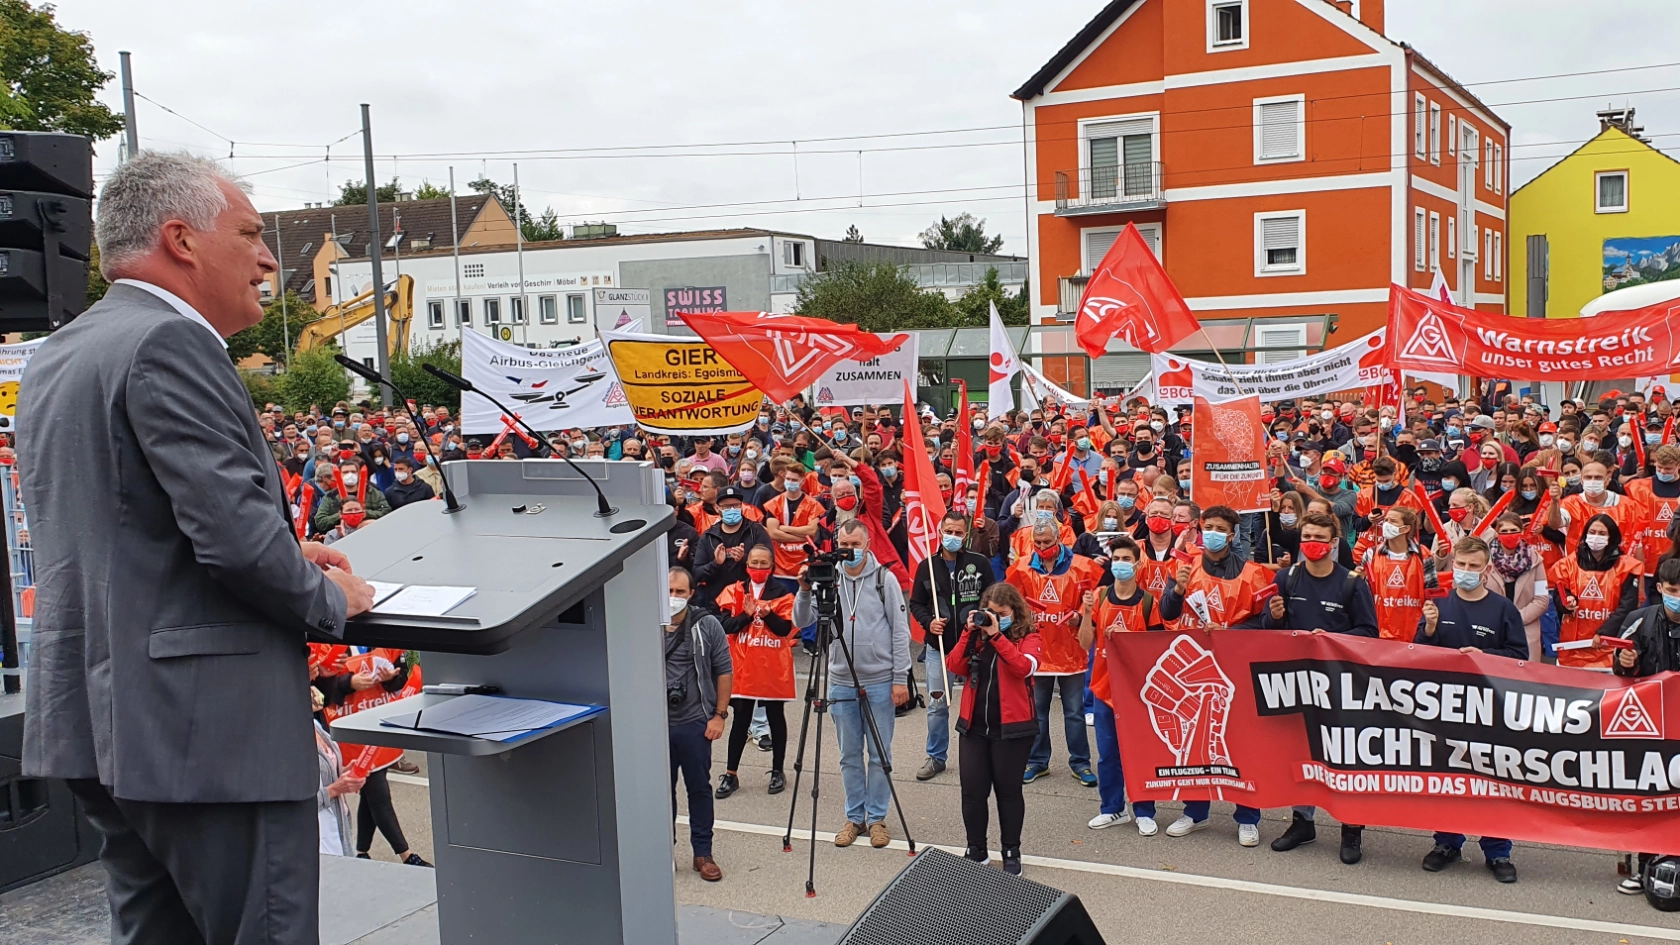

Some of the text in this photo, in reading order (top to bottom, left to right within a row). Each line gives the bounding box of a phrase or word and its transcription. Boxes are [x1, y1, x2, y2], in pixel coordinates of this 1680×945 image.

[487, 281, 509, 289] Verleih
[524, 280, 552, 288] Geschirr
[556, 278, 577, 286] Möbel
[667, 289, 723, 306] SWISS
[1476, 325, 1654, 355] Warnstreik
[0, 348, 27, 357] hrung
[489, 349, 608, 368] Airbus-Gleichgewi
[557, 347, 589, 357] neue
[665, 348, 718, 366] GIER
[1481, 346, 1654, 373] unser gutes Recht
[634, 367, 743, 380] Landkreis: Egoismu
[836, 371, 901, 382] ZUSAMMEN
[1238, 375, 1263, 384] zieht
[1265, 373, 1294, 383] ihnen
[1297, 366, 1321, 378] aber
[1324, 356, 1352, 372] nicht
[1217, 385, 1236, 395] das
[1258, 386, 1281, 395] über
[1284, 383, 1301, 392] die
[1302, 373, 1339, 389] Ohren!
[661, 389, 726, 404] SOZIALE
[632, 400, 759, 420] VERANTWORTUNG
[1205, 462, 1260, 471] ZUSAMMENHALTEN
[1579, 607, 1611, 620] streik
[1257, 670, 1593, 734] WIR LASSEN UNS
[1320, 724, 1437, 767] NICHT
[1158, 768, 1170, 776] EIN
[1171, 767, 1205, 776] FLUGZEUG
[1210, 767, 1222, 775] EIN
[1145, 779, 1176, 789] ZUKUNFT
[1177, 778, 1194, 787] GEHT
[1196, 778, 1210, 786] NUR
[1301, 763, 1680, 812] DIE REGION UND DAS WERK AUGSBURG STE
